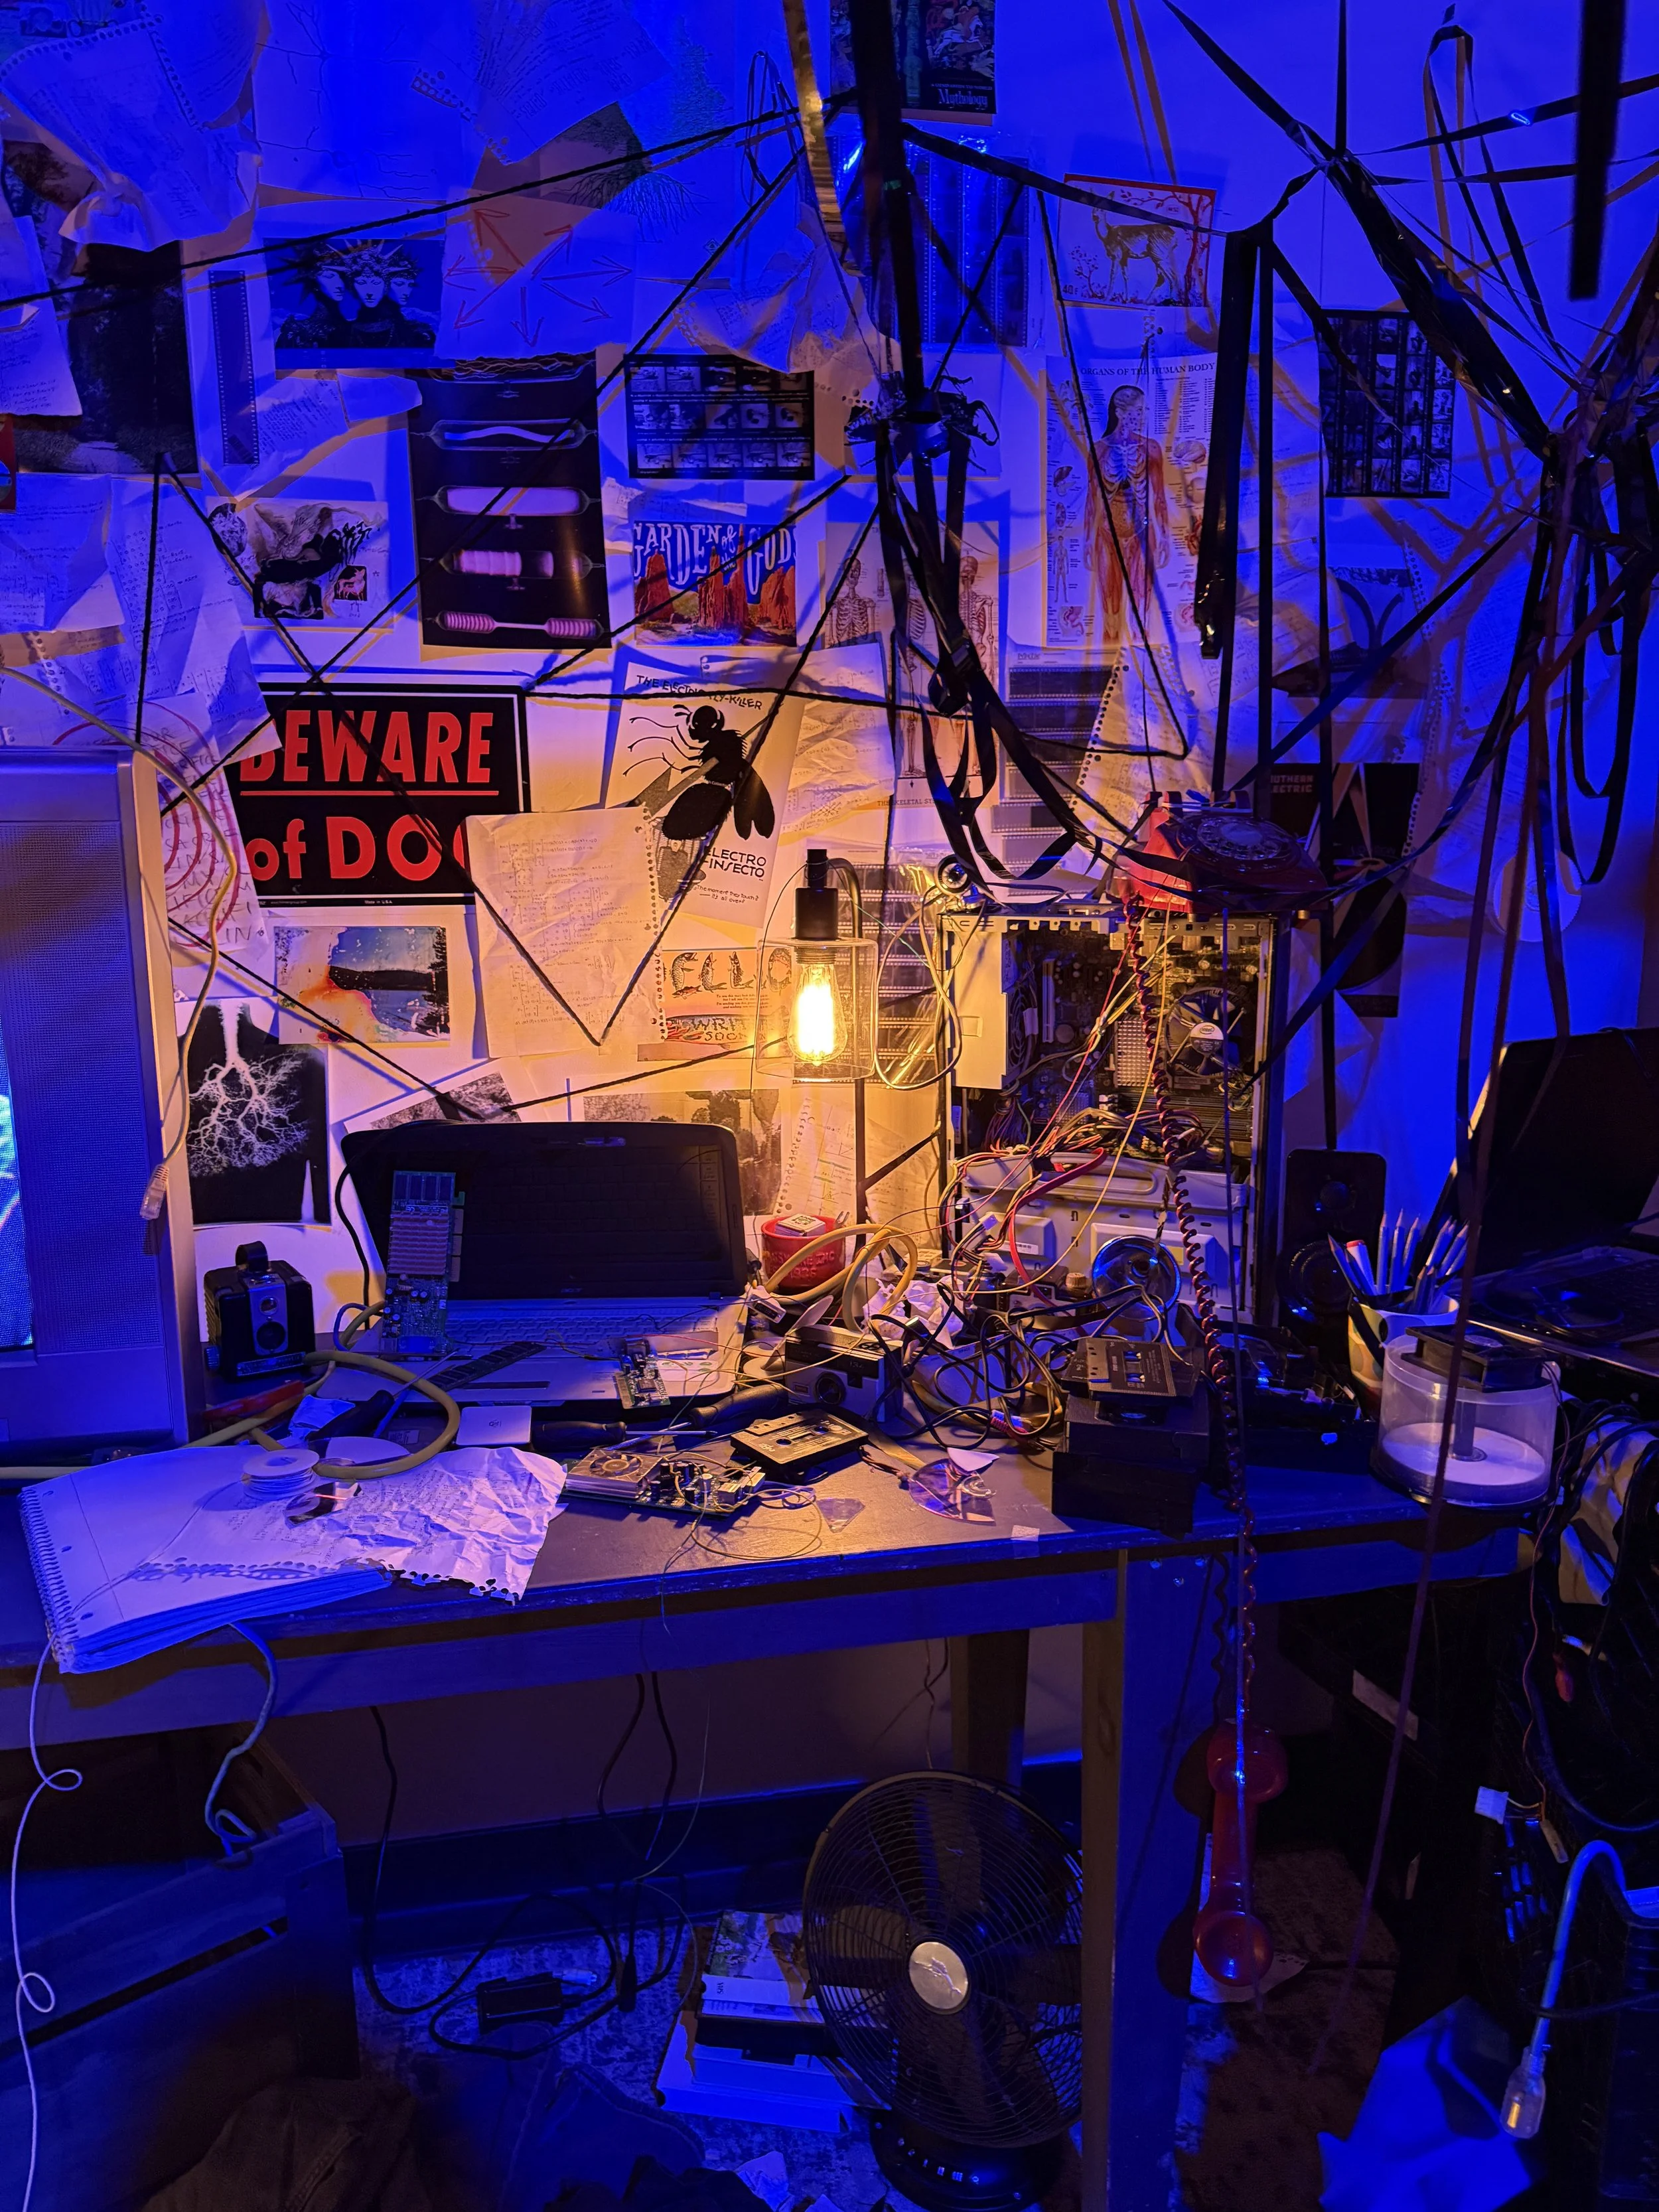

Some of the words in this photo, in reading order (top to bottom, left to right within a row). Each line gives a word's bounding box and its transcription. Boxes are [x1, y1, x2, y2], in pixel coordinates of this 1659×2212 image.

[937, 88, 988, 110] Mythology
[1080, 367, 1116, 376] ORGANS
[1151, 365, 1187, 375] HUMAN
[1188, 362, 1215, 372] BODY
[636, 674, 660, 688] THE
[708, 694, 763, 711] LY-KILLER
[1269, 774, 1314, 784] UTHERN
[1270, 784, 1313, 794] ECTRIC
[246, 818, 307, 881] of
[707, 847, 767, 867] LECTRO
